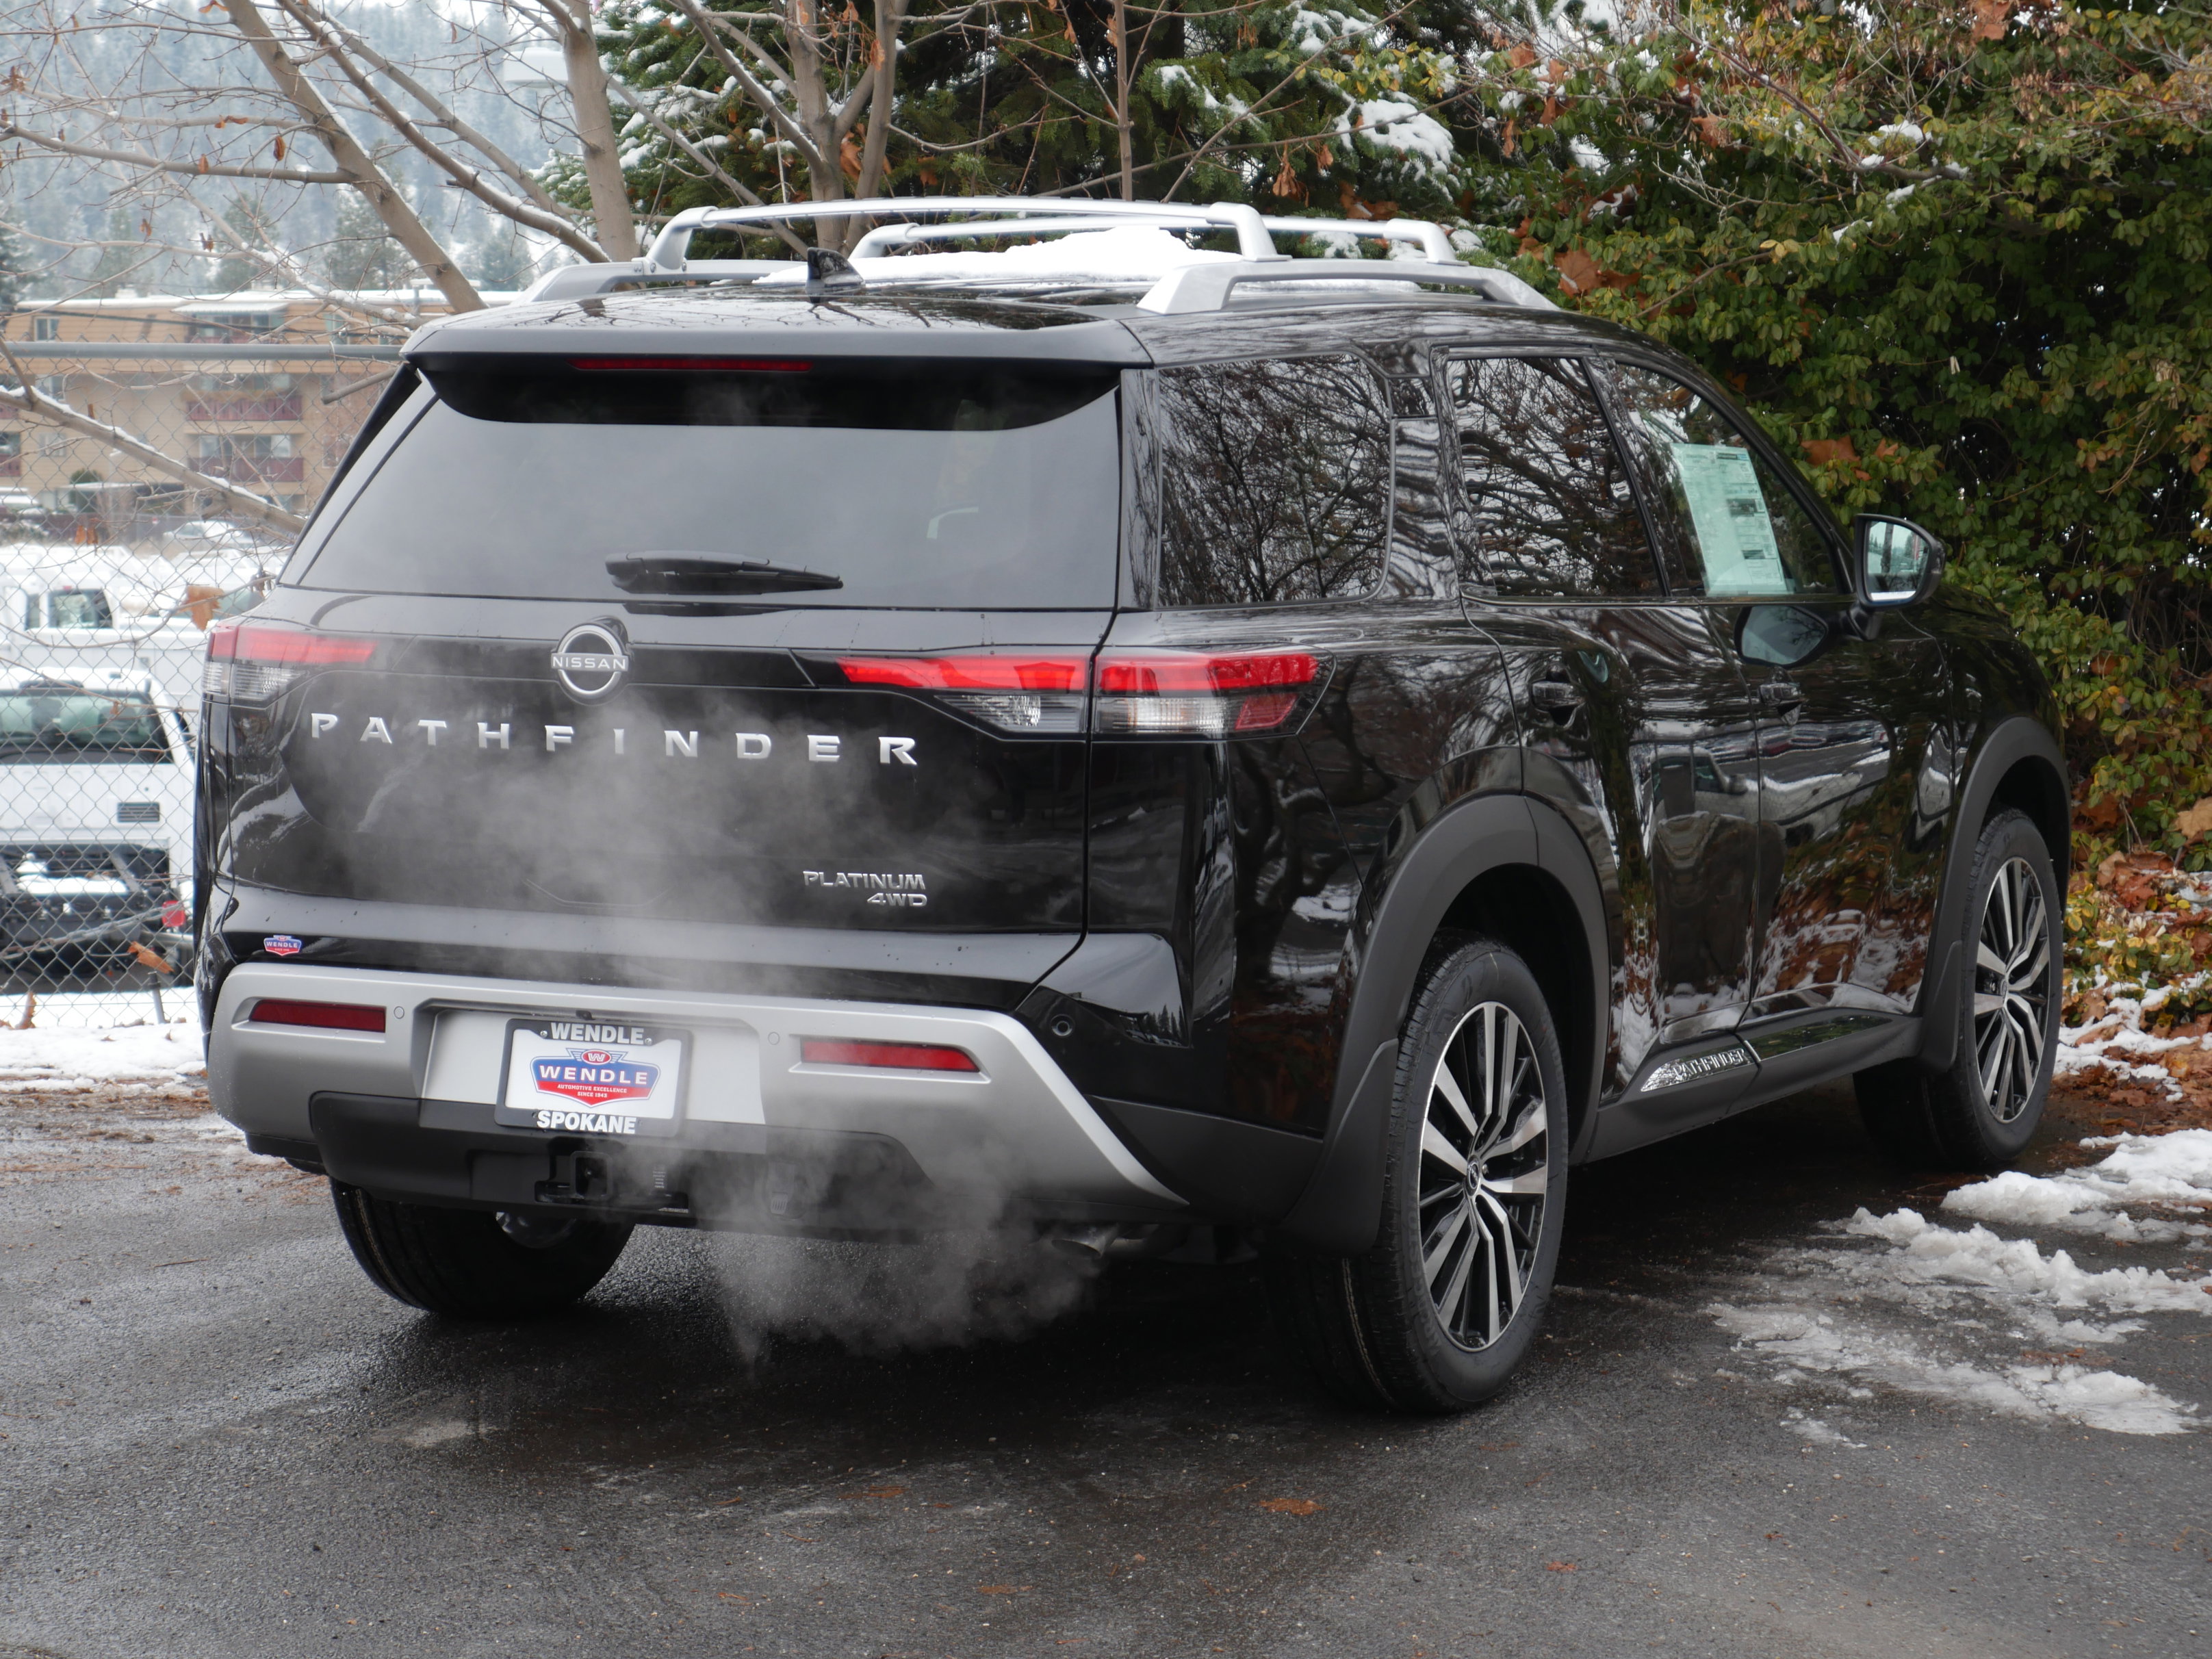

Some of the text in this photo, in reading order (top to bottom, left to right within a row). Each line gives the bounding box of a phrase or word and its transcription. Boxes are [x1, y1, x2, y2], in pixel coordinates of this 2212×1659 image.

[553, 656, 626, 669] NISSAN
[311, 713, 917, 765] PATHFINDER
[803, 871, 926, 890] PLATINUM
[866, 892, 927, 907] 4WD
[551, 1022, 644, 1045] WENDLE
[1673, 1048, 1747, 1076] PATHFINDER
[539, 1065, 647, 1085] WENDLE
[537, 1110, 636, 1134] SPOKANE
